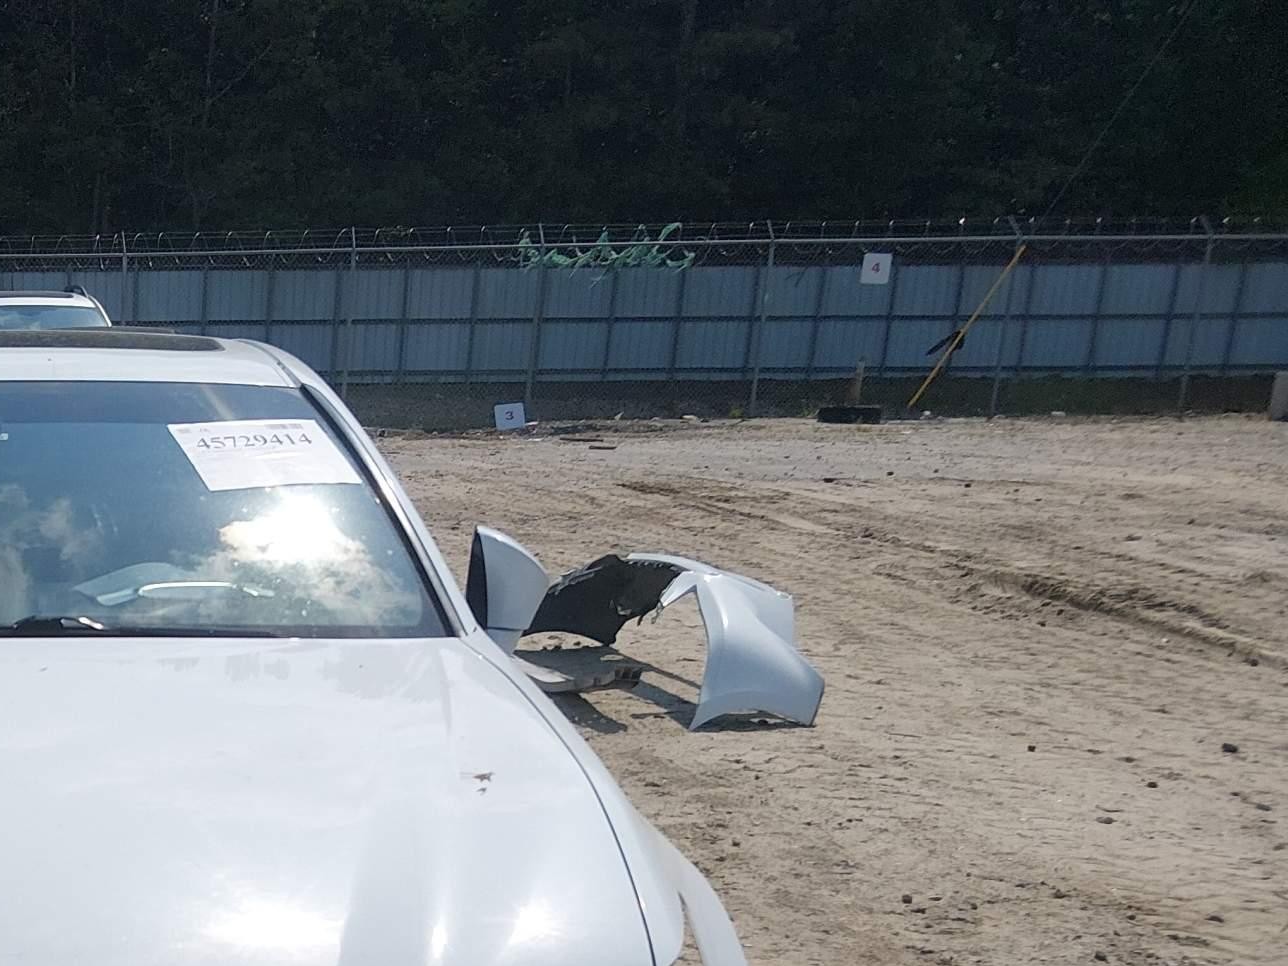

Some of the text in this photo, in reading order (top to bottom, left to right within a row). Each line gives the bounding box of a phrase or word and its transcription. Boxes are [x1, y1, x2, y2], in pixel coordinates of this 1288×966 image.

[871, 263, 881, 273] 4
[504, 410, 514, 421] 3
[197, 432, 312, 450] 45729414
